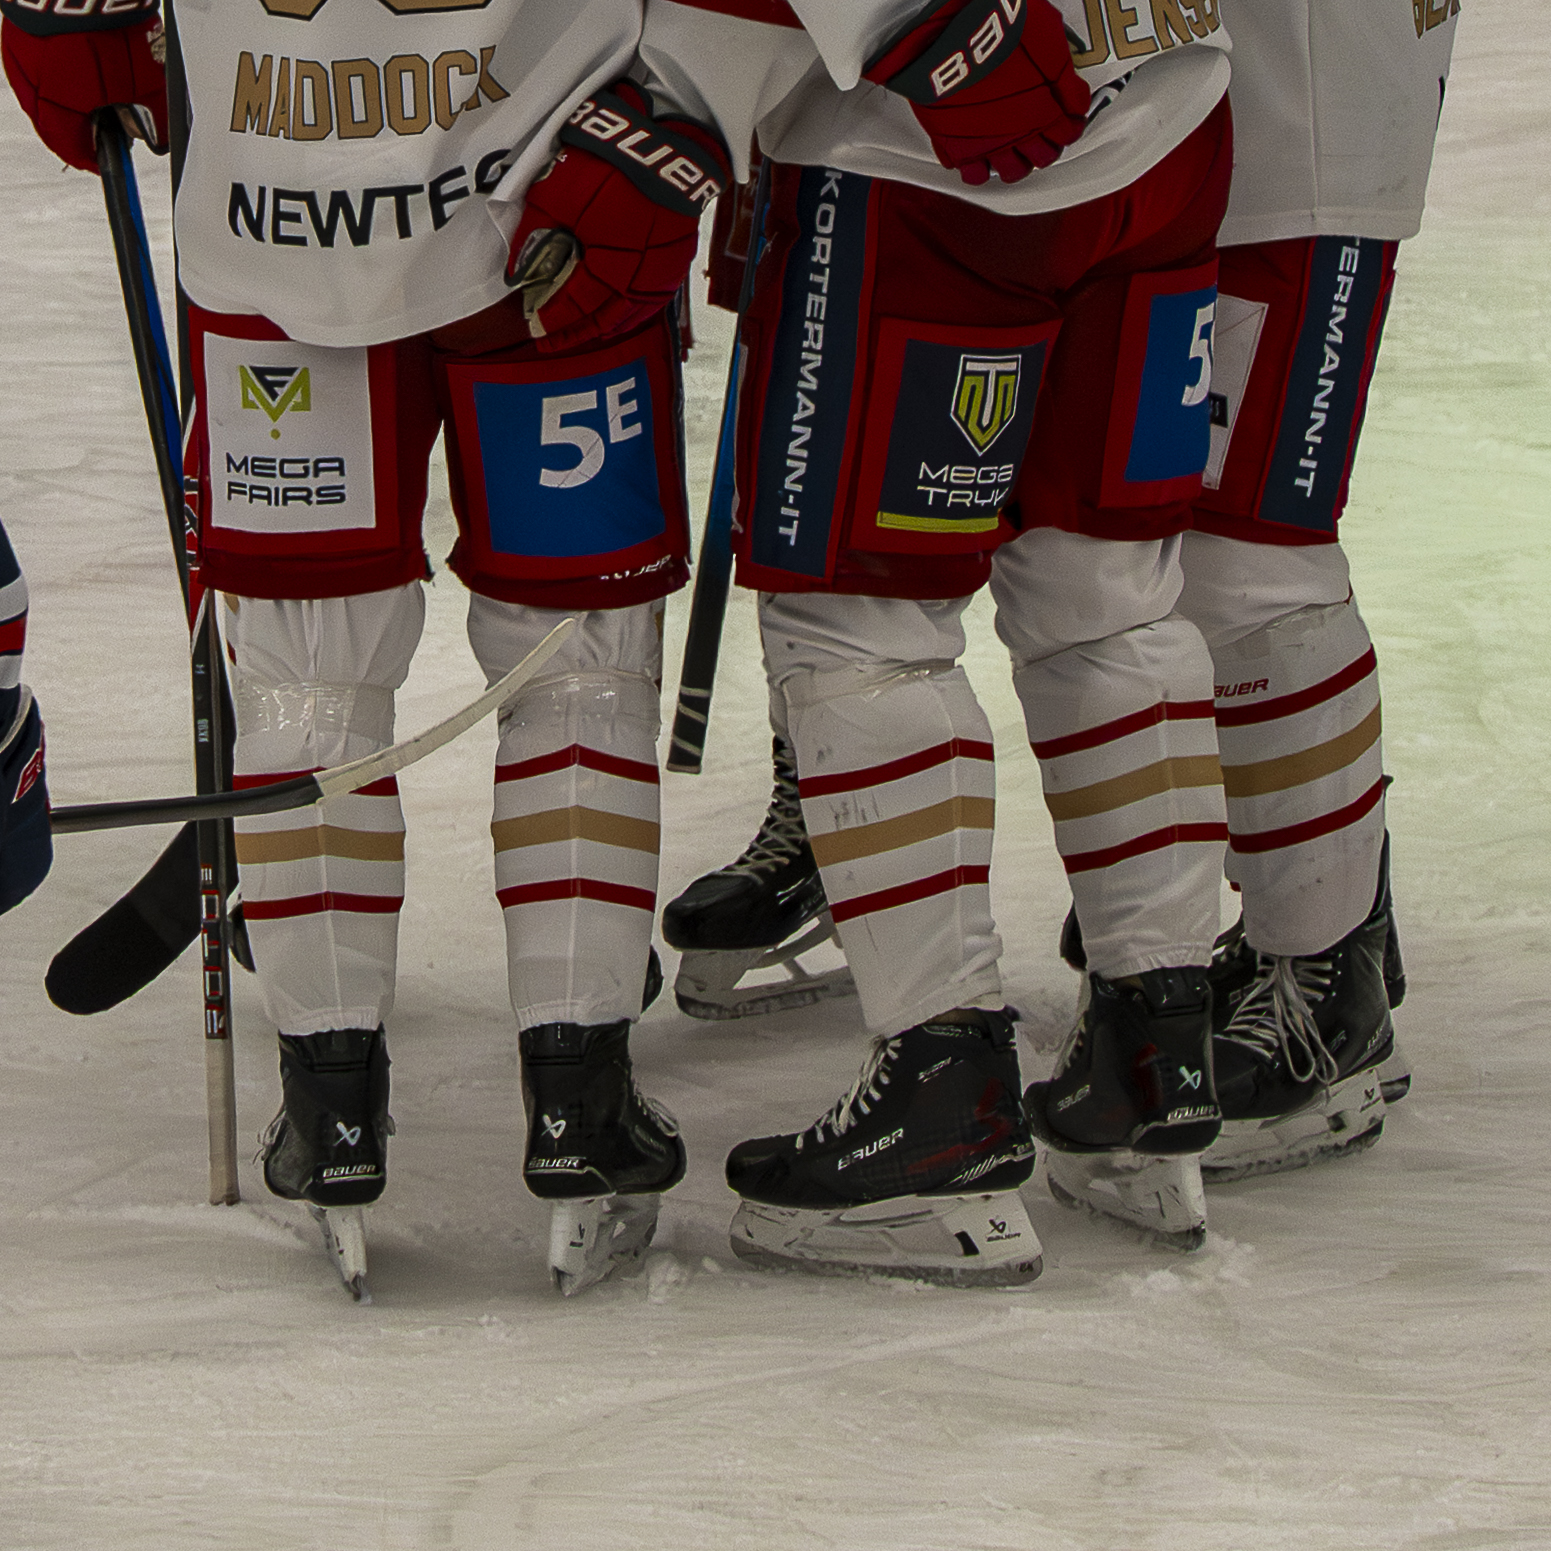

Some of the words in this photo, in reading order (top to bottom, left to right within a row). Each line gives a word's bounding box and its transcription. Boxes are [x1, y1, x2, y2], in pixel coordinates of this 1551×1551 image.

[229, 44, 511, 142] MADDOCK
[778, 168, 844, 548] KORTERMANN-IT
[1293, 236, 1361, 499] ERMANN-IT
[224, 451, 347, 480] MEGA
[918, 461, 1015, 485] MEGA
[225, 482, 347, 508] FAIRS
[1213, 675, 1270, 699] AUER
[837, 1127, 905, 1172] BAUER
[322, 1162, 377, 1179] BAUER
